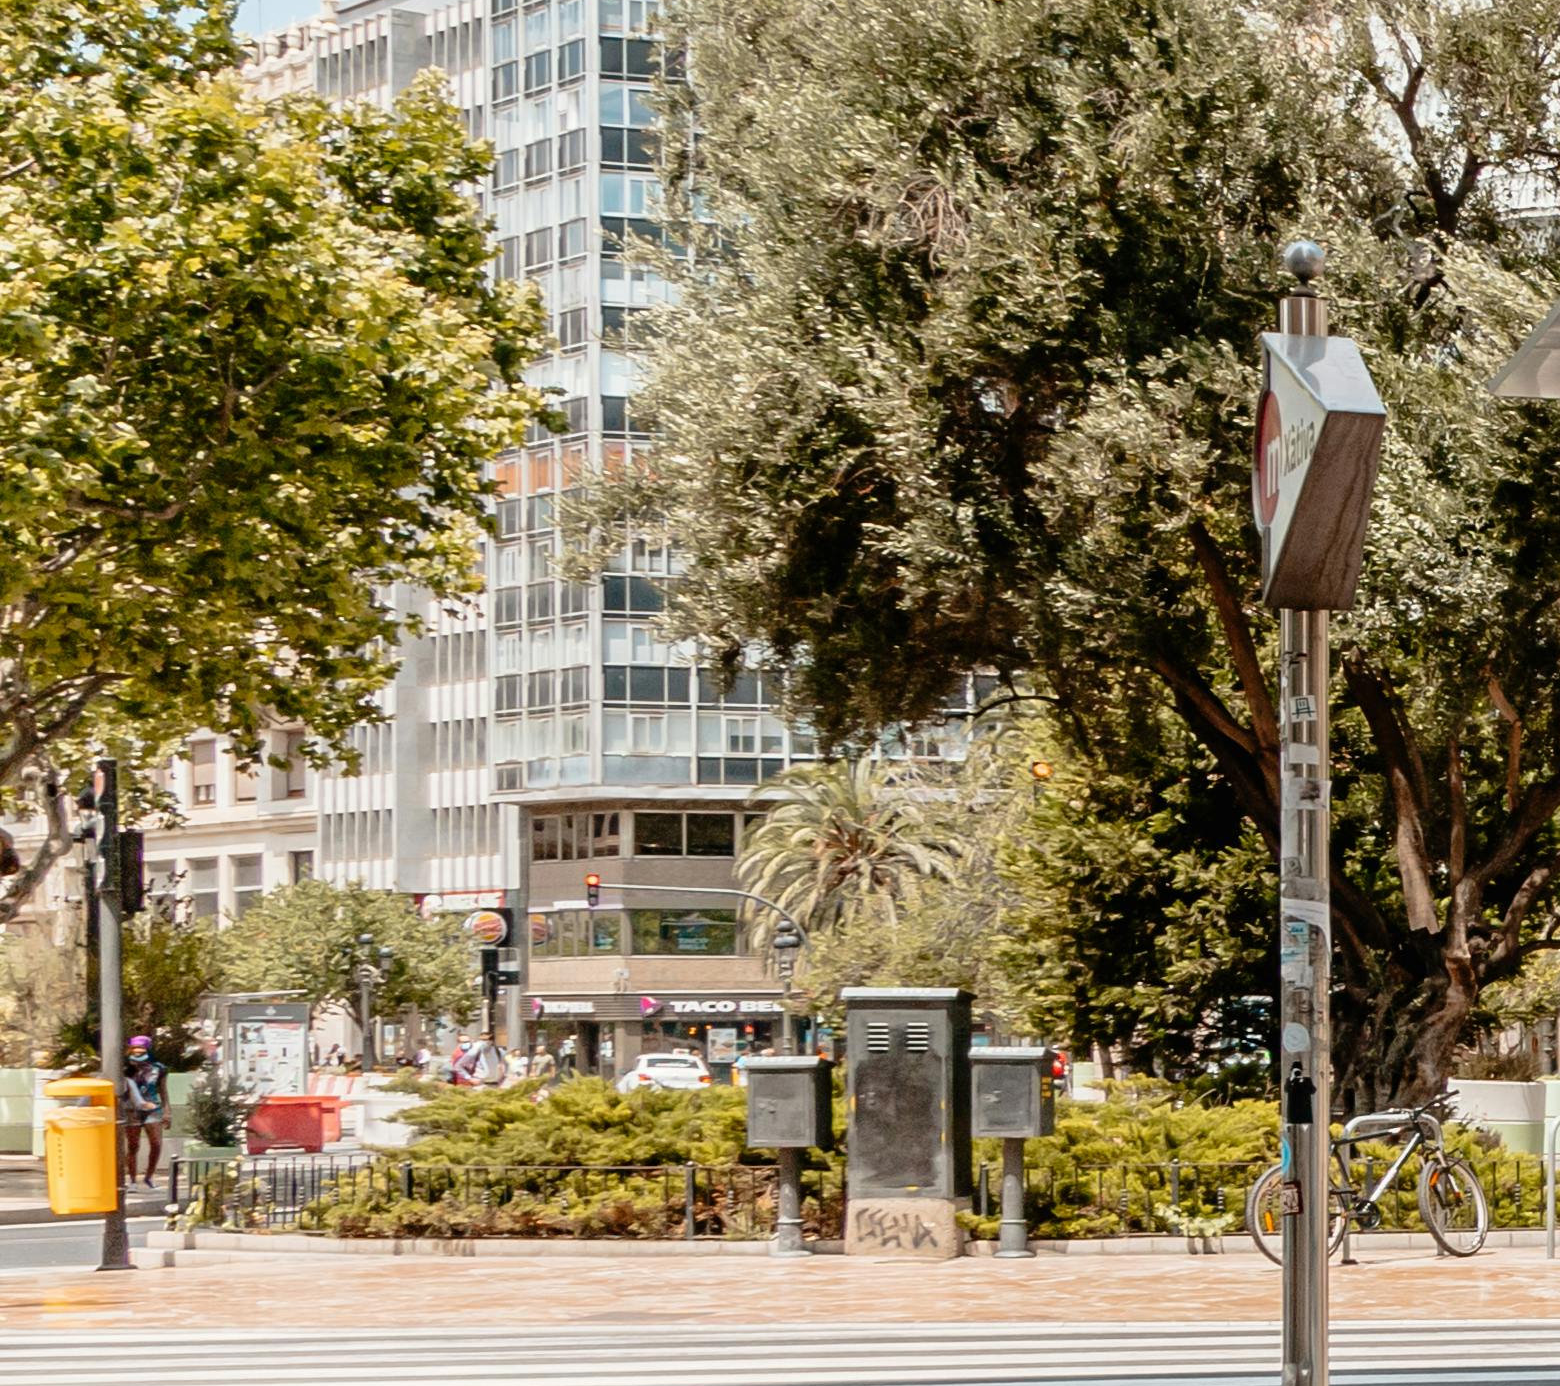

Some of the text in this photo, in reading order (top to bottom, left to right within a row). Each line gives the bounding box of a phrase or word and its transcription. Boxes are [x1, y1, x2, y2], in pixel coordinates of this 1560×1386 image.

[1281, 418, 1316, 477] Xàtiva
[669, 1000, 786, 1013] TACO BEL
